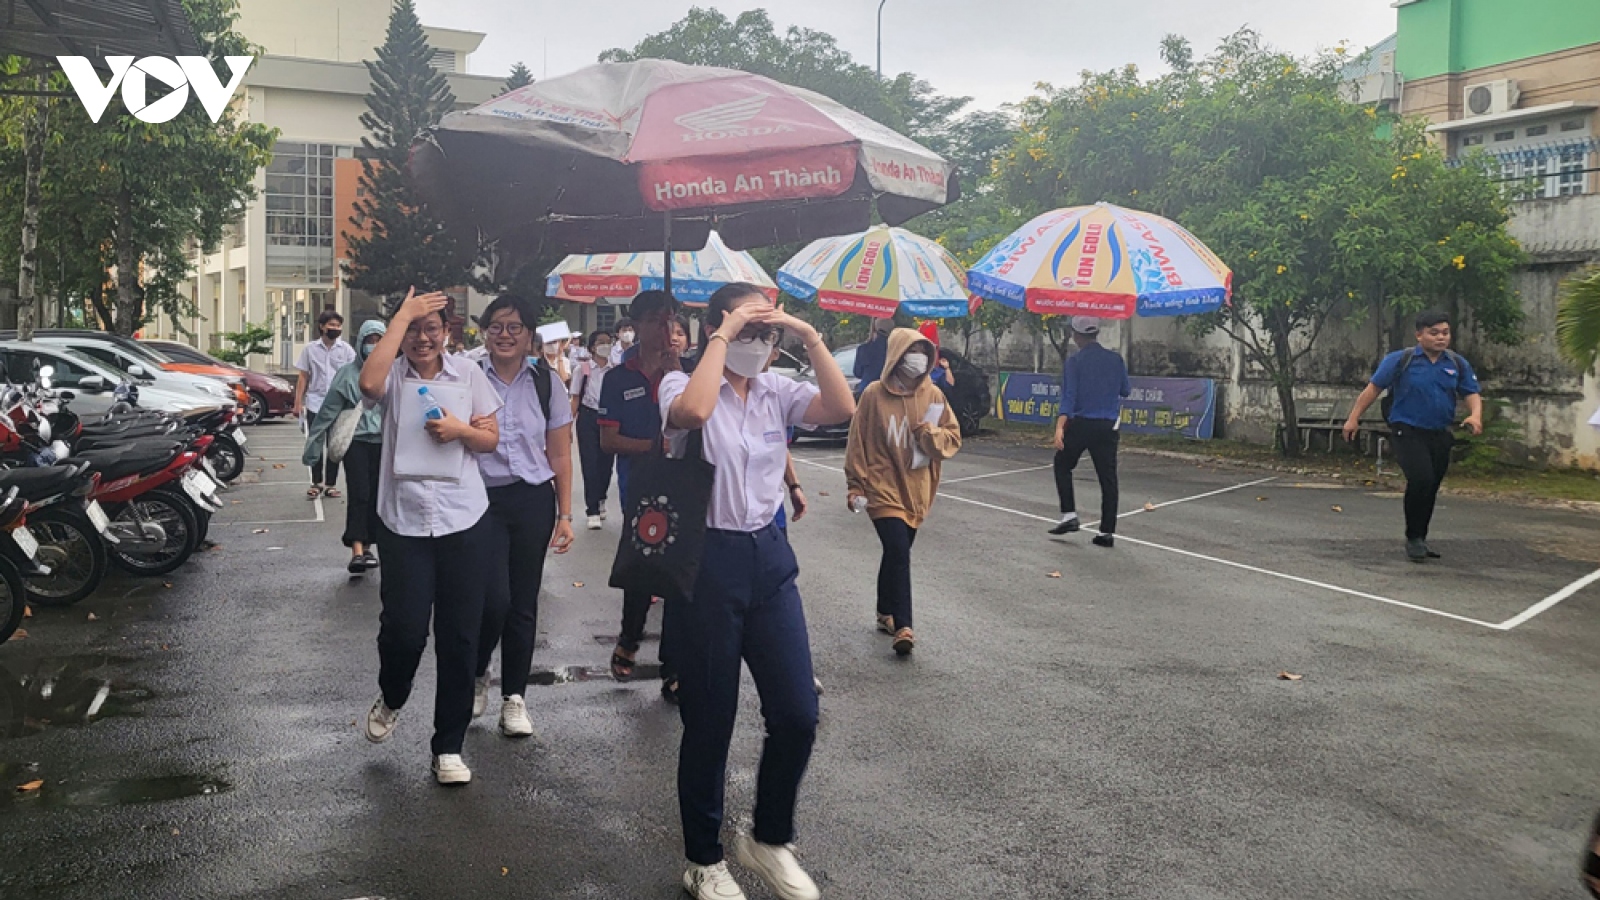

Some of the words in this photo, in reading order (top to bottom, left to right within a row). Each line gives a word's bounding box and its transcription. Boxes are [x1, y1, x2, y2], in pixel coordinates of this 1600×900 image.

[680, 123, 796, 142] HONDA
[654, 176, 727, 200] Honda
[734, 164, 764, 192] An
[769, 156, 841, 188] Thành
[1082, 223, 1103, 253] GOLD
[861, 241, 881, 265] GOLD
